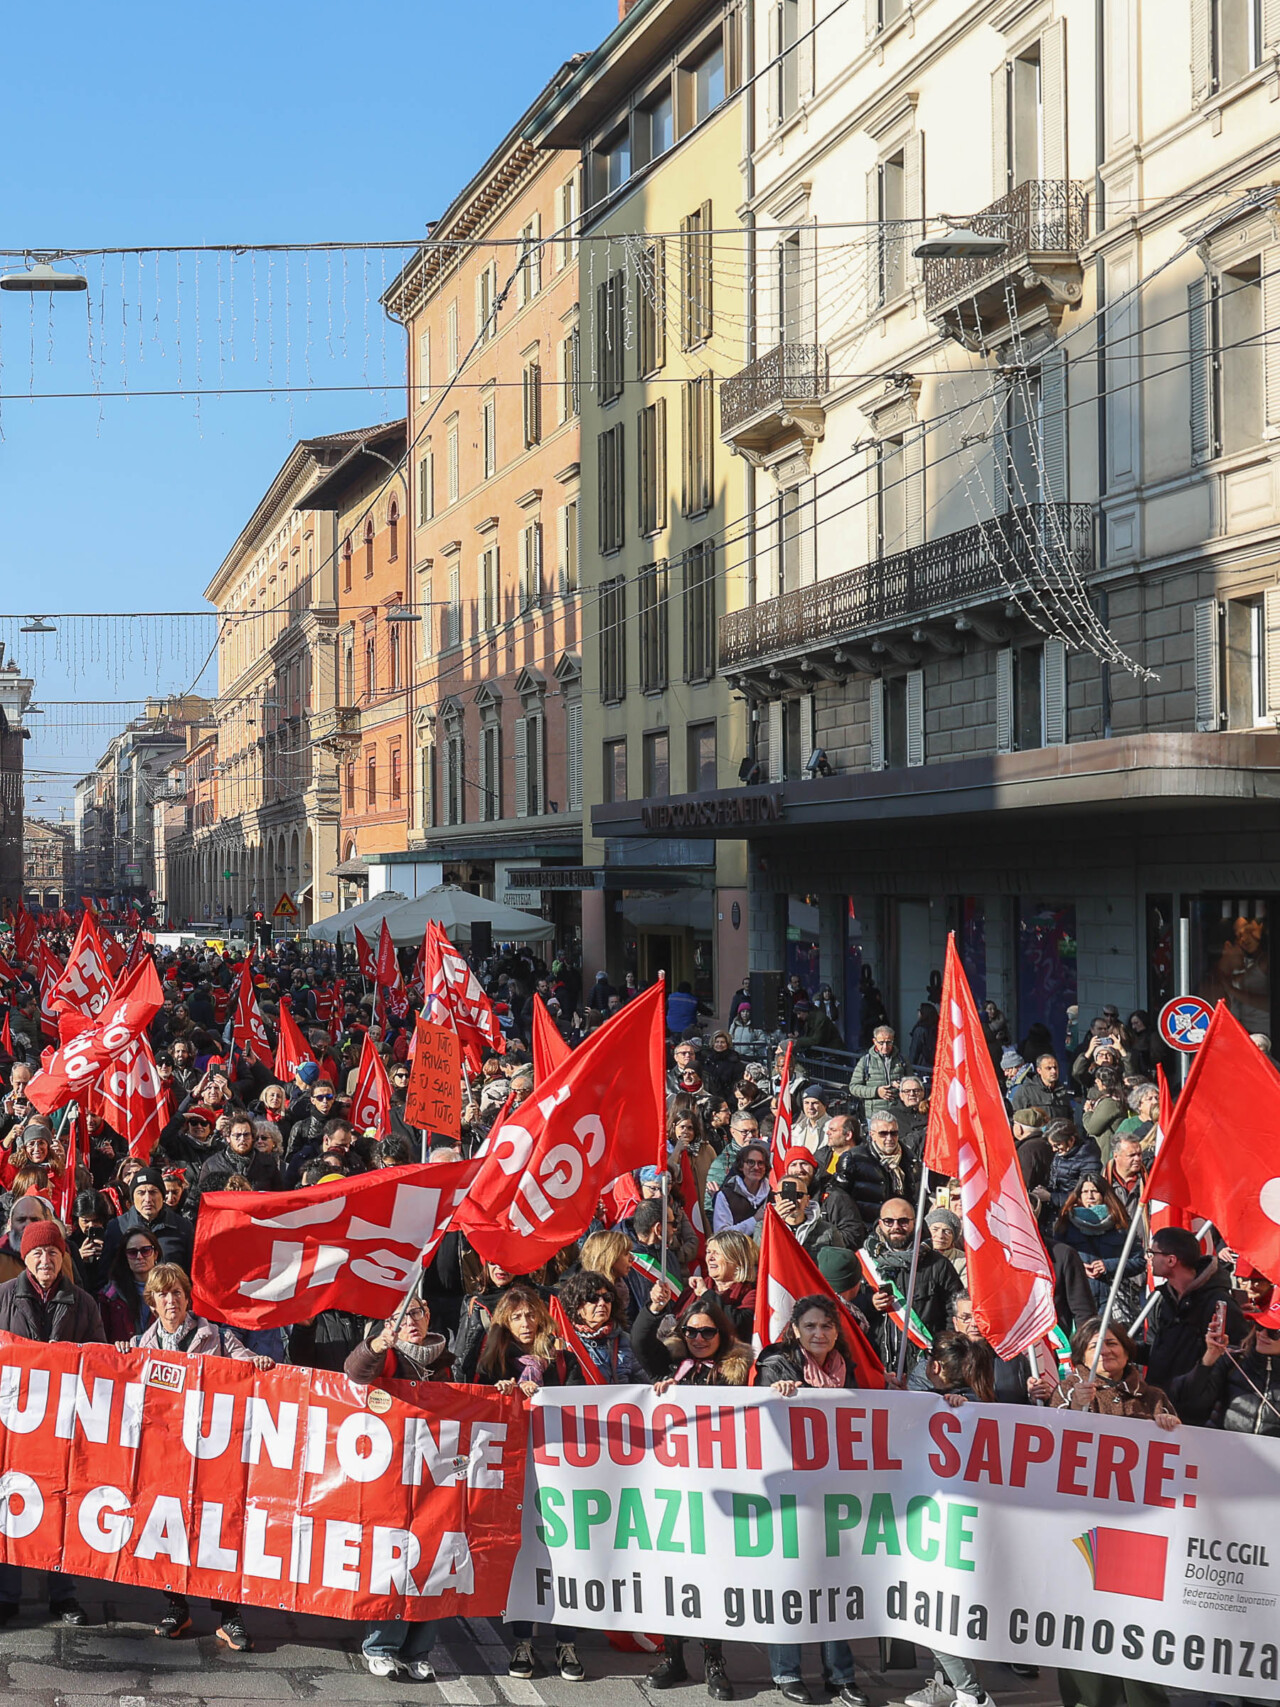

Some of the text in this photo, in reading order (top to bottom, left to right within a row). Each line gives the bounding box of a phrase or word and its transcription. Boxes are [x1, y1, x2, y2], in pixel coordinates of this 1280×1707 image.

[422, 1051, 451, 1075] PRIVATO
[431, 1100, 454, 1125] TUTTO
[150, 1364, 181, 1384] AGD
[182, 1389, 508, 1489] UNIONE
[531, 1402, 1198, 1509] LUOGHI DEL SAPERE:
[78, 1485, 474, 1597] GALLIERA
[535, 1486, 978, 1572] SPAZI DI PACE
[1187, 1537, 1269, 1567] FLC CGIL
[1185, 1563, 1244, 1587] Bologna
[1183, 1587, 1277, 1607] federazione lavoratori
[1198, 1600, 1247, 1613] conoscenza
[536, 1567, 1279, 1681] Fuori la guerra dalla conoscenza
